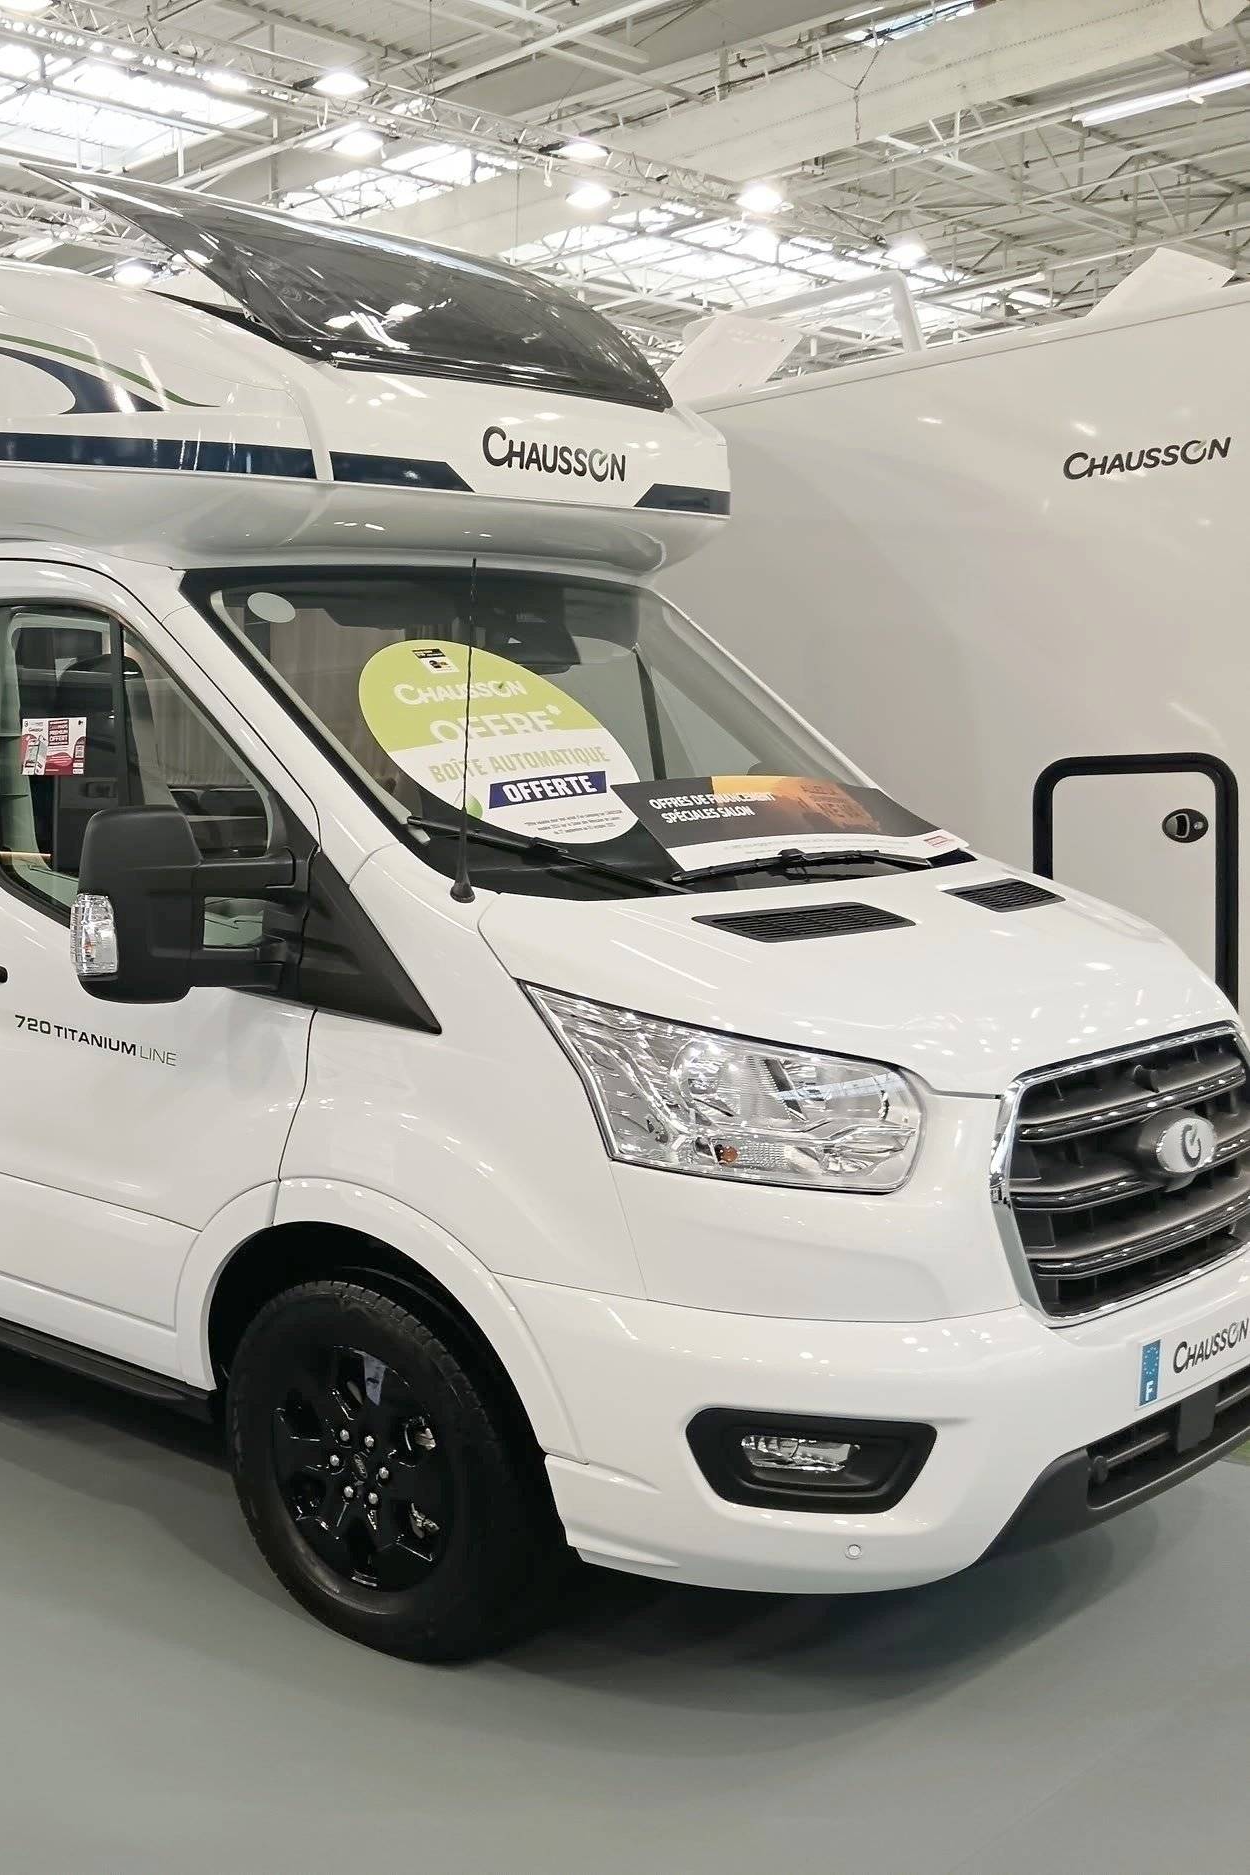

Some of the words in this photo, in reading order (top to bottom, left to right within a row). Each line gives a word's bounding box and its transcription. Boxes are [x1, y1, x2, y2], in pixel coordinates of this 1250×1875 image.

[482, 425, 626, 482] CHAUSSON
[1063, 437, 1232, 480] CHAUSSON
[393, 681, 528, 705] CHAUSSON
[429, 757, 488, 783] BOÎTE
[488, 746, 611, 773] AUTOMATIQUE
[502, 775, 598, 803] OFFERTE
[649, 795, 694, 810] OFFRES
[692, 794, 709, 806] DE
[661, 807, 721, 824] SPÉCIALES
[718, 805, 756, 818] SALON
[15, 1014, 51, 1035] 720
[53, 1025, 137, 1056] TITANIUM
[139, 1045, 177, 1067] LINE
[1173, 1317, 1250, 1374] CHAUSSON
[1144, 1380, 1154, 1402] F
